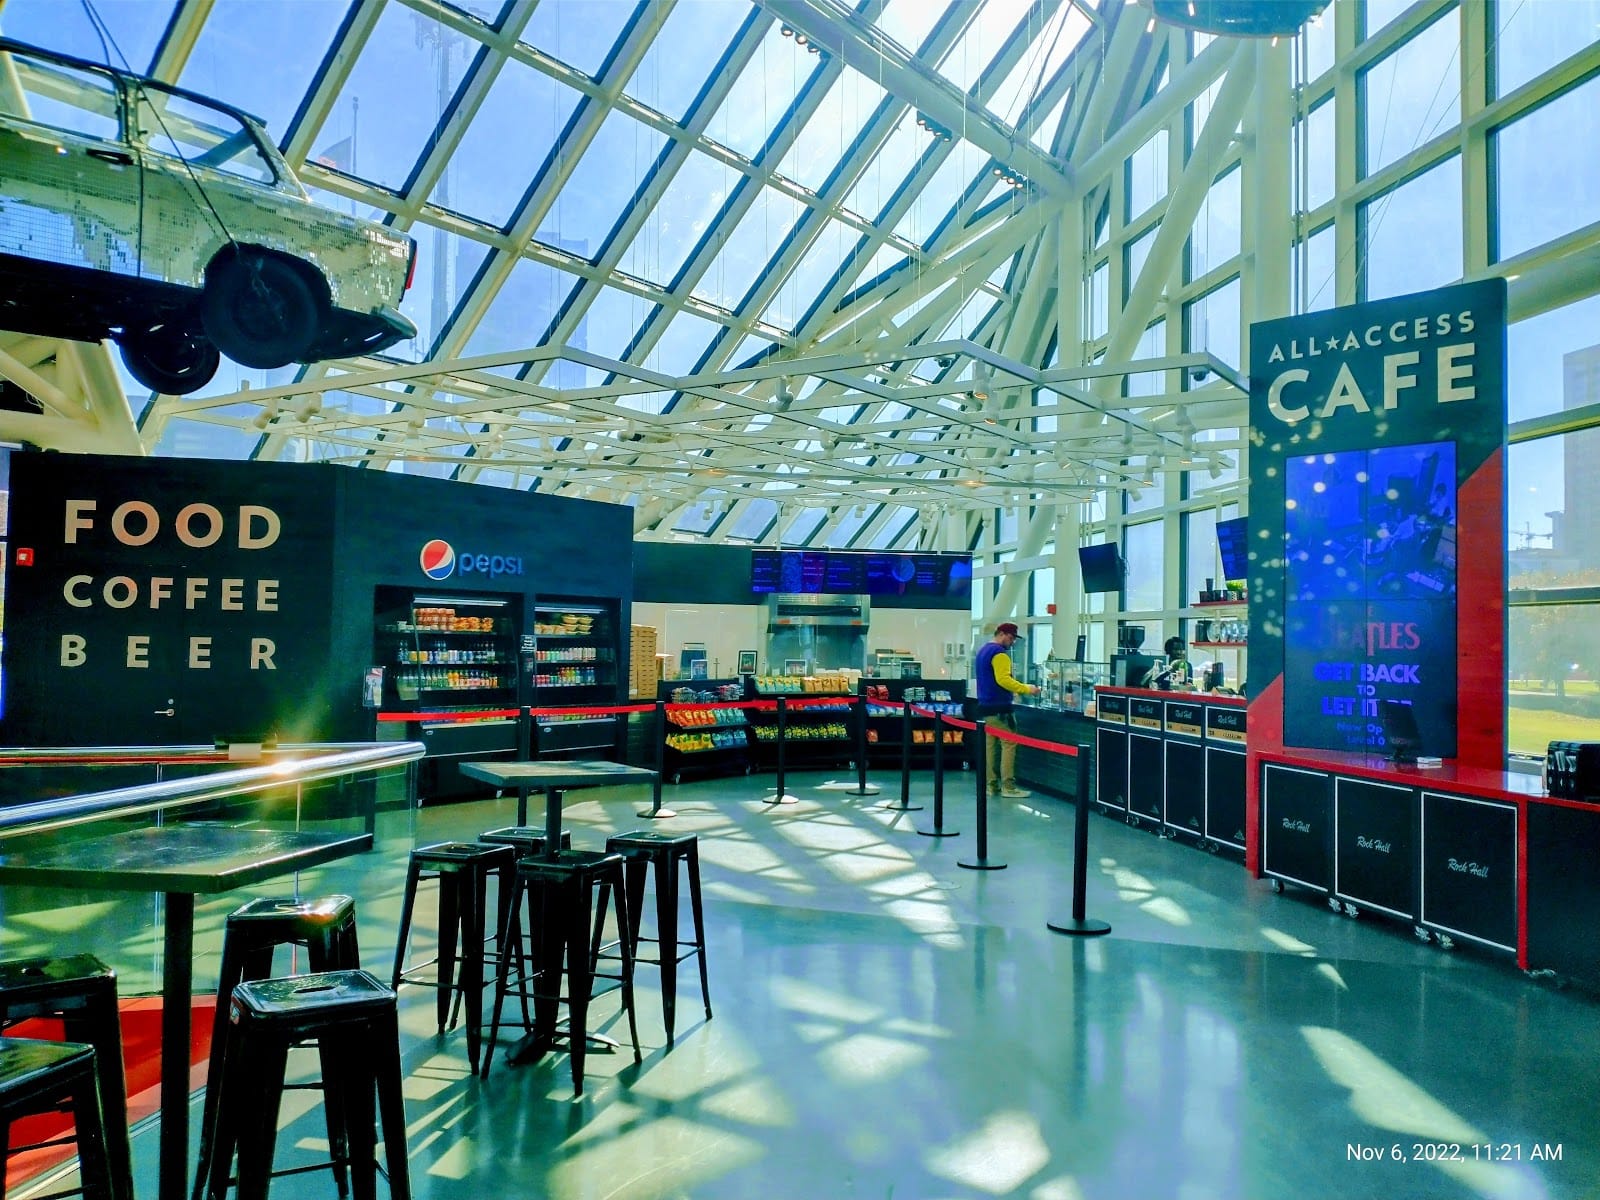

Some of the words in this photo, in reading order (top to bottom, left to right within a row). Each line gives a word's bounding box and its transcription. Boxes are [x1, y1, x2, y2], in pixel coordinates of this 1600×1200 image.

[1268, 336, 1322, 363] ALL
[1342, 310, 1475, 352] ACCESS
[1267, 342, 1476, 423] CAFE
[64, 499, 281, 549] FOOD
[458, 552, 523, 578] pepsi
[63, 574, 280, 612] COFFEE
[60, 634, 278, 670] BEER
[1360, 663, 1421, 684] BACK
[1356, 684, 1376, 696] TO
[1321, 697, 1356, 716] LET
[1360, 698, 1379, 717] IT
[1447, 858, 1468, 873] Rock
[1468, 862, 1489, 878] Hall
